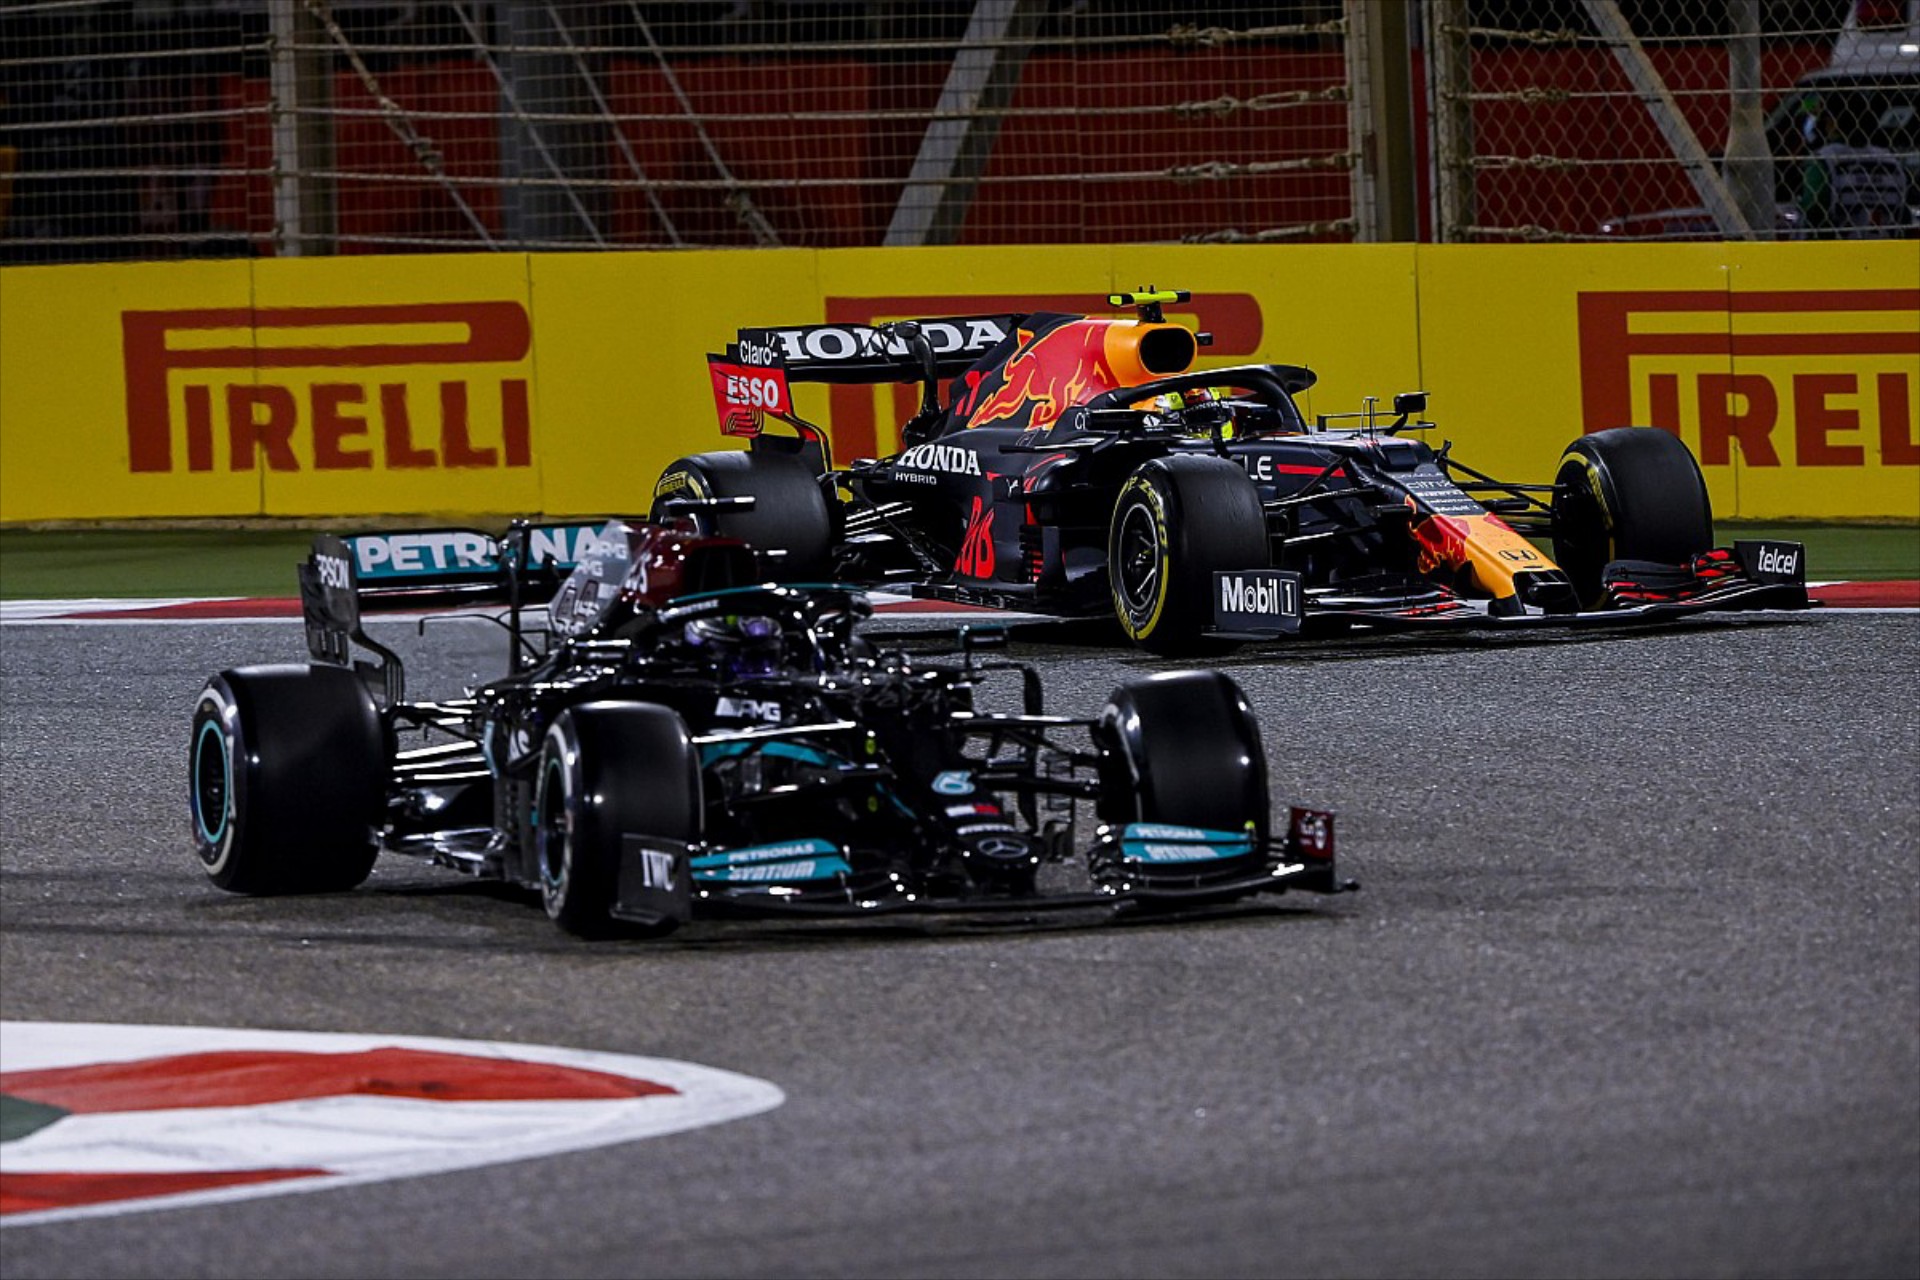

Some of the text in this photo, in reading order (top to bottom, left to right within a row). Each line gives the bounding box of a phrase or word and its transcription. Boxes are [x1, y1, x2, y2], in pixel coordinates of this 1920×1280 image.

[740, 338, 773, 366] Claro
[121, 301, 532, 473] PIRELLI
[726, 375, 779, 408] ESSO
[897, 444, 981, 476] HONDA
[895, 472, 937, 485] HYBRID
[356, 526, 606, 572] PETRNA
[1758, 545, 1798, 575] telcel
[1221, 575, 1279, 615] Mobil
[728, 842, 815, 862] PETRONAS
